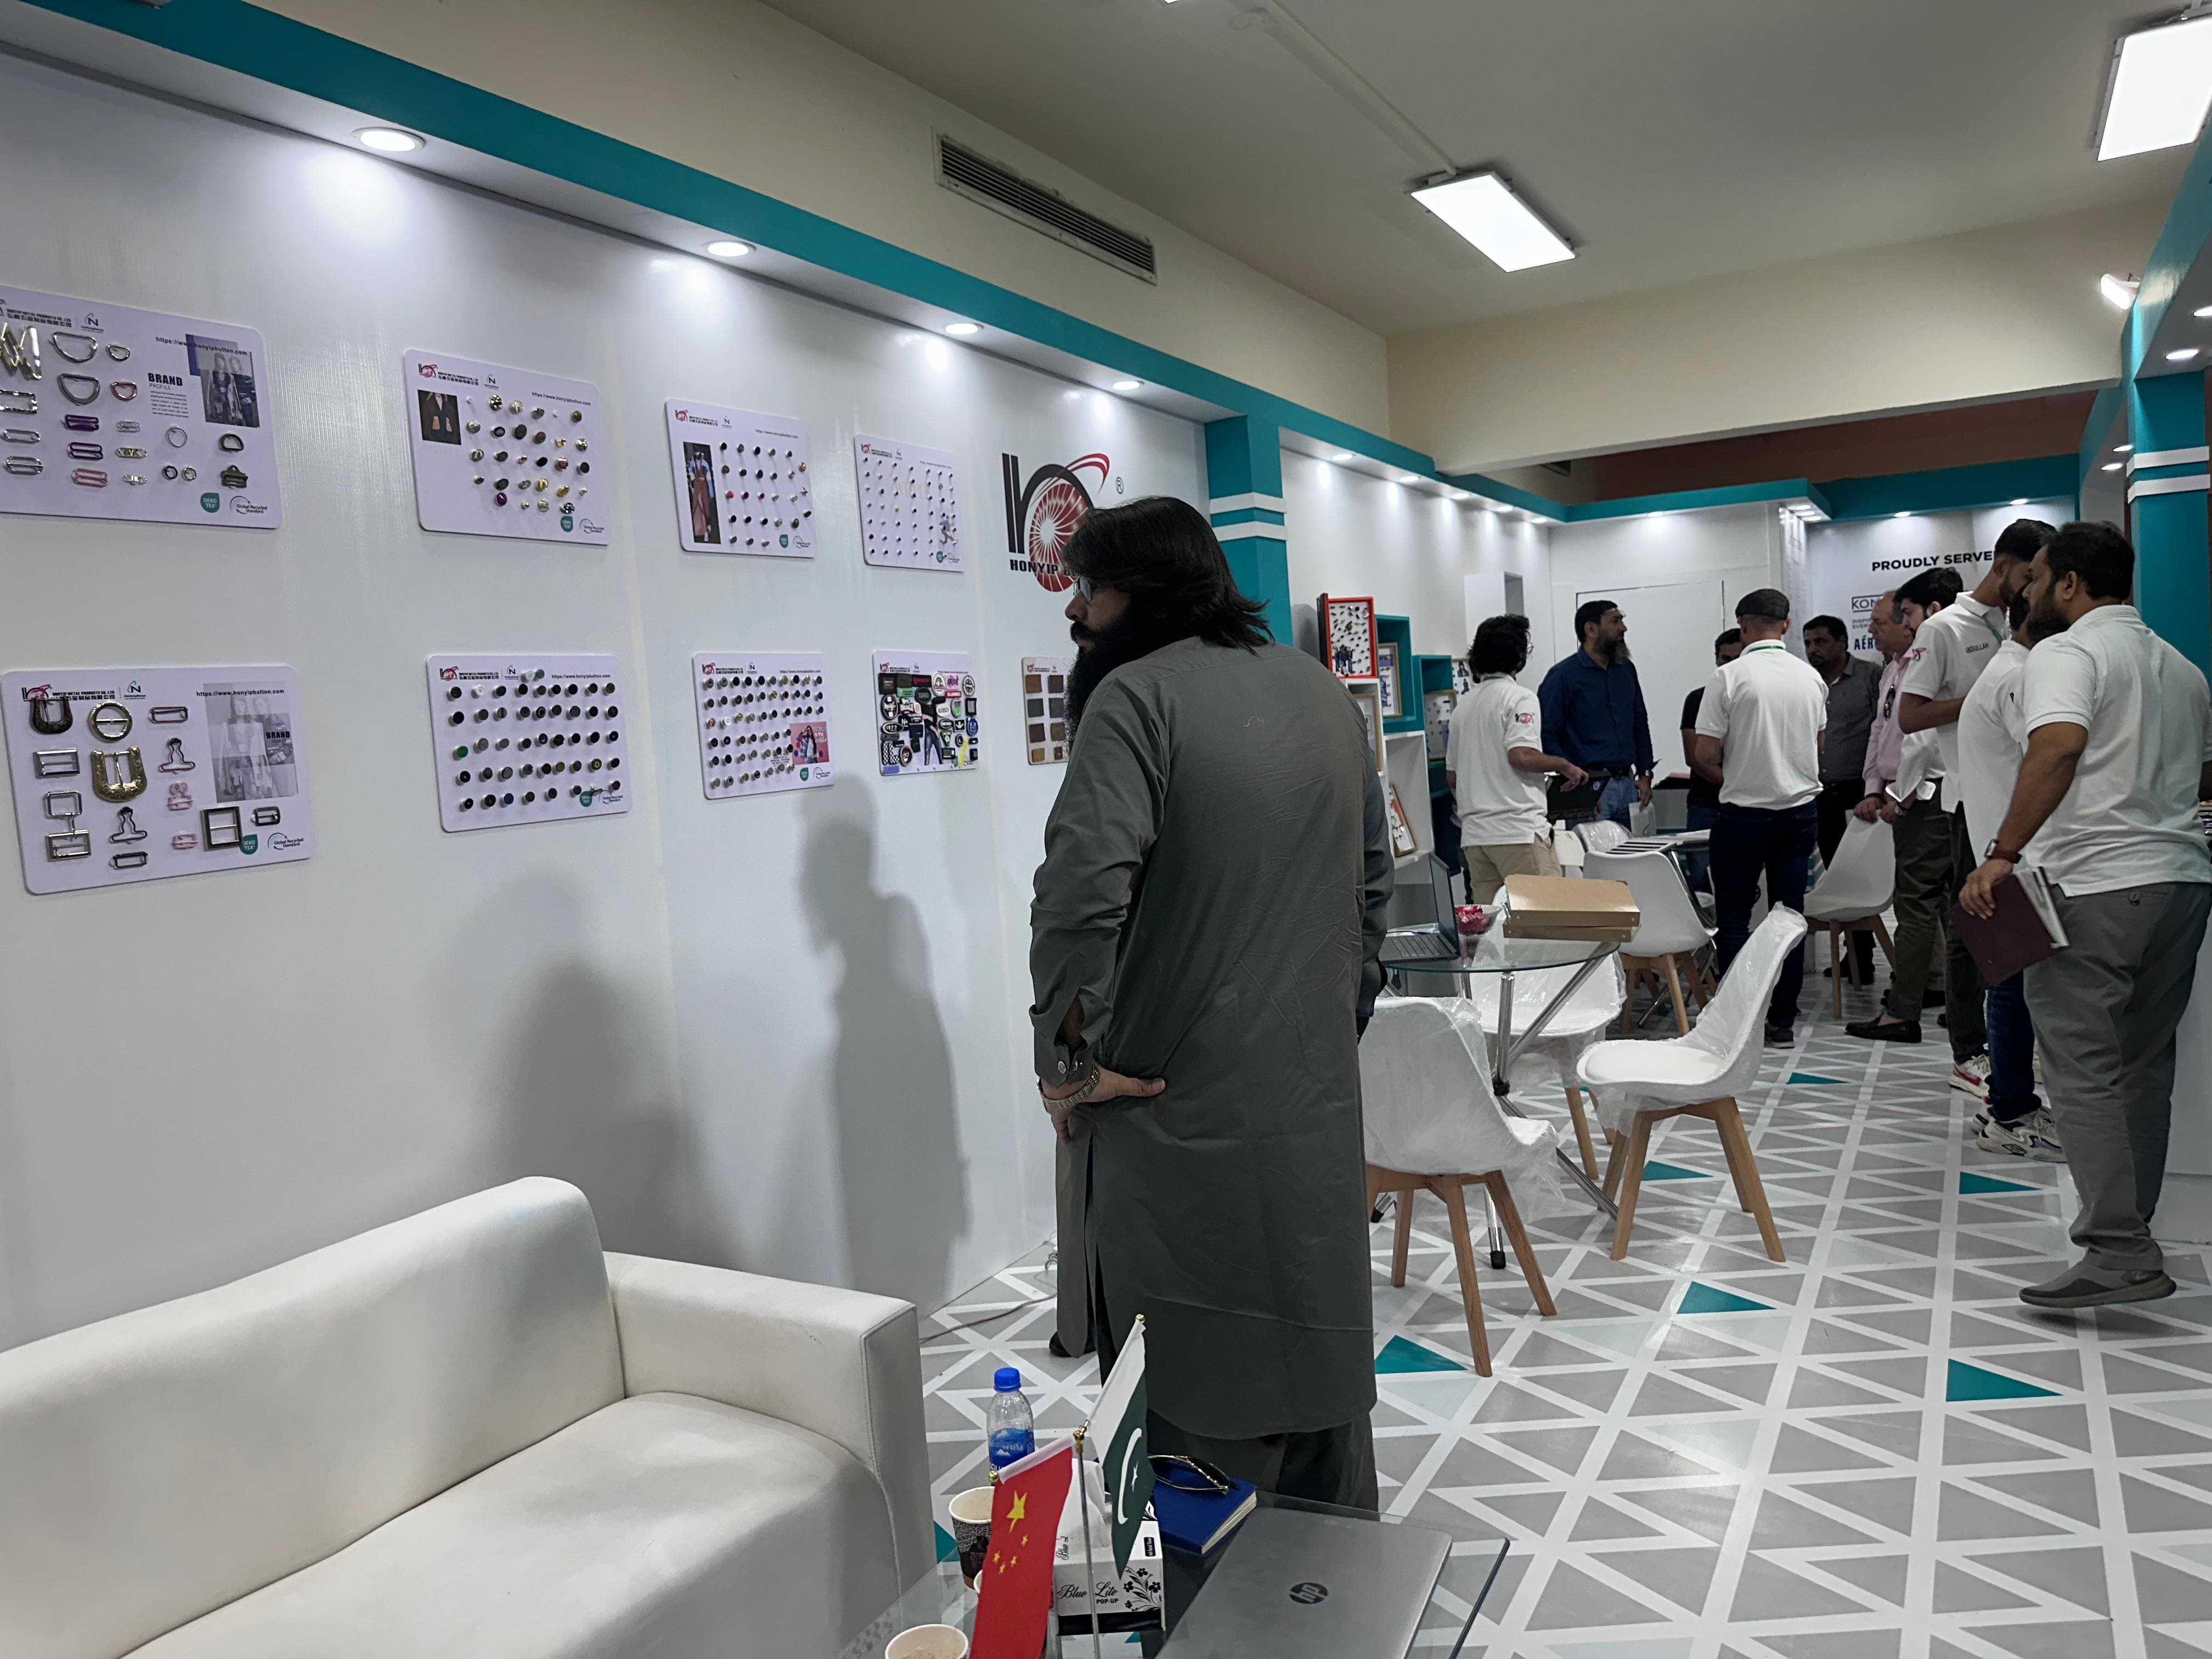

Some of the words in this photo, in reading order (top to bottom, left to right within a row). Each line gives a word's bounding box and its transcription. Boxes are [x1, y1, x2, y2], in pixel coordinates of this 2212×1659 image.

[148, 373, 183, 386] BRAND
[1010, 559, 1059, 574] HONYIP
[1872, 556, 1939, 571] PROUDLY
[1854, 635, 1876, 650] AÉR
[266, 731, 290, 739] BRAND
[1057, 1584, 1087, 1599] Blue
[1094, 1581, 1118, 1598] Lite
